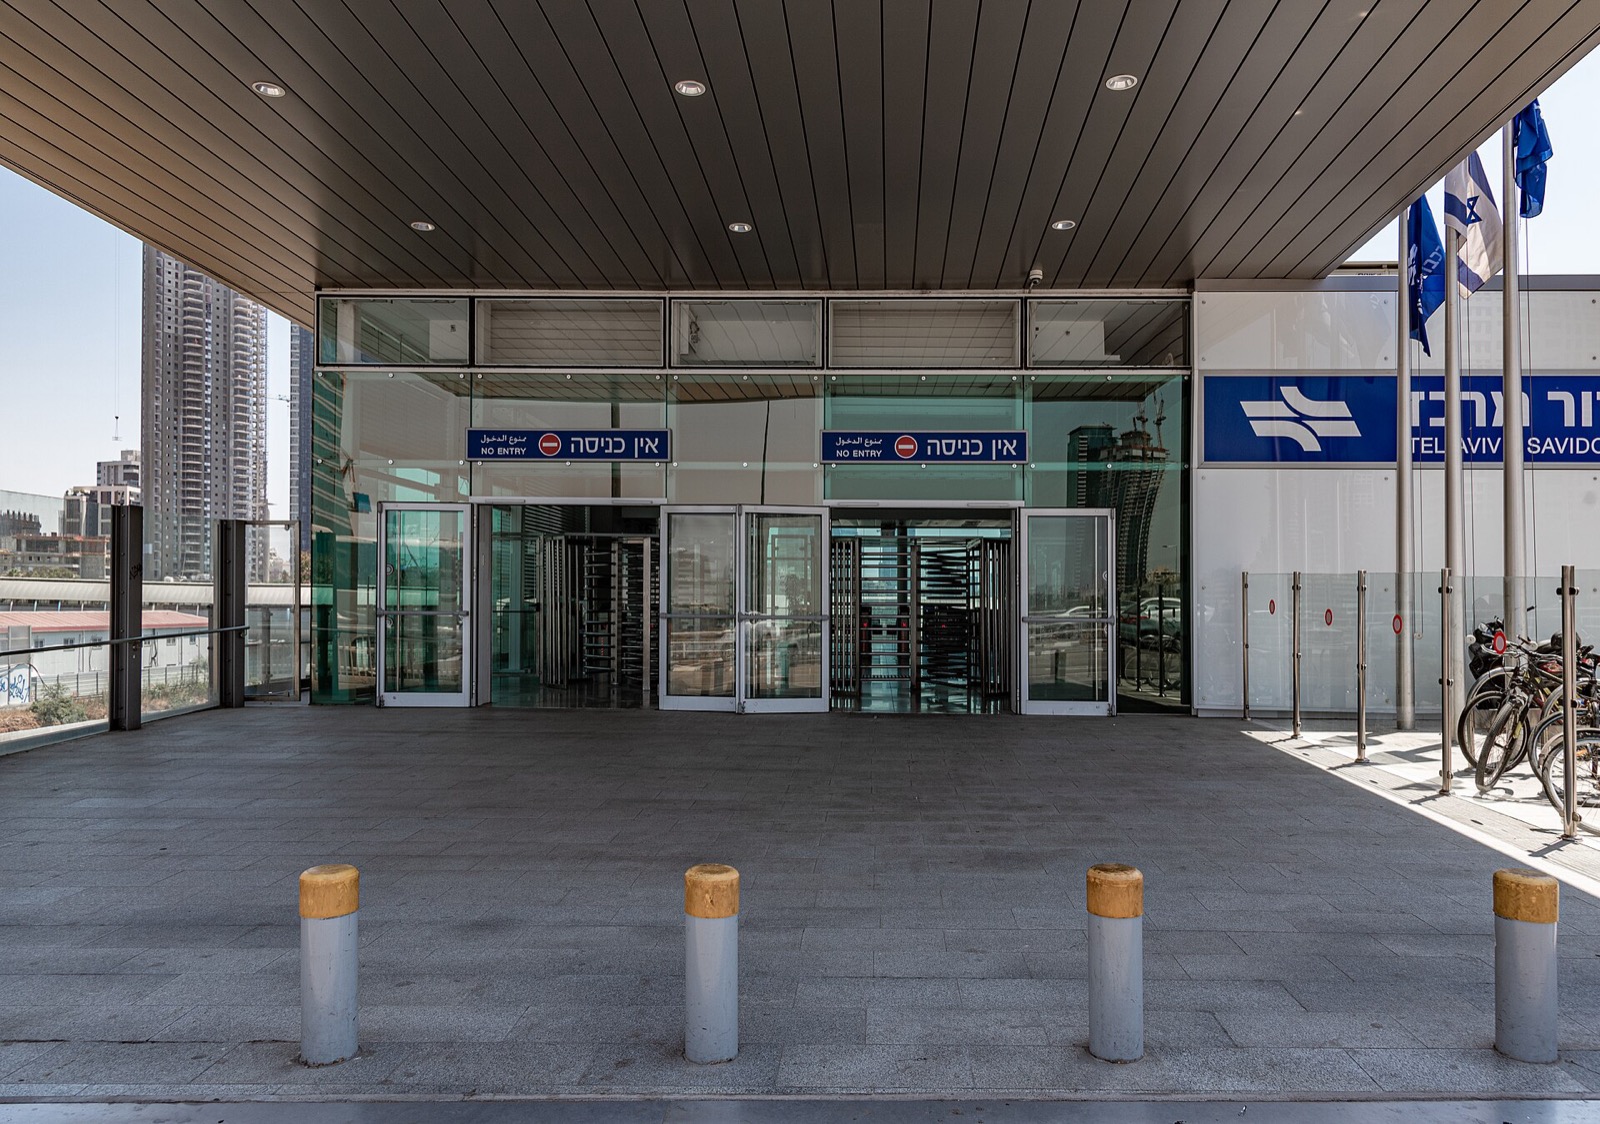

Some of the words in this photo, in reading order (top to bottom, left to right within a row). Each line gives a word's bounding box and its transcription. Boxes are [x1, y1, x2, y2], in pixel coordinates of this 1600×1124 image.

[1548, 391, 1600, 427] ור
[481, 434, 506, 444] الدخول
[570, 437, 626, 453] כניסה
[836, 436, 862, 447] الدخول
[927, 439, 983, 455] כניסה
[1411, 437, 1446, 454] TEL
[481, 447, 495, 455] NO
[497, 447, 526, 455] ENTRY
[634, 437, 659, 459] אין
[836, 449, 850, 458] NO
[852, 449, 882, 458] ENTRY
[992, 439, 1017, 461] אין
